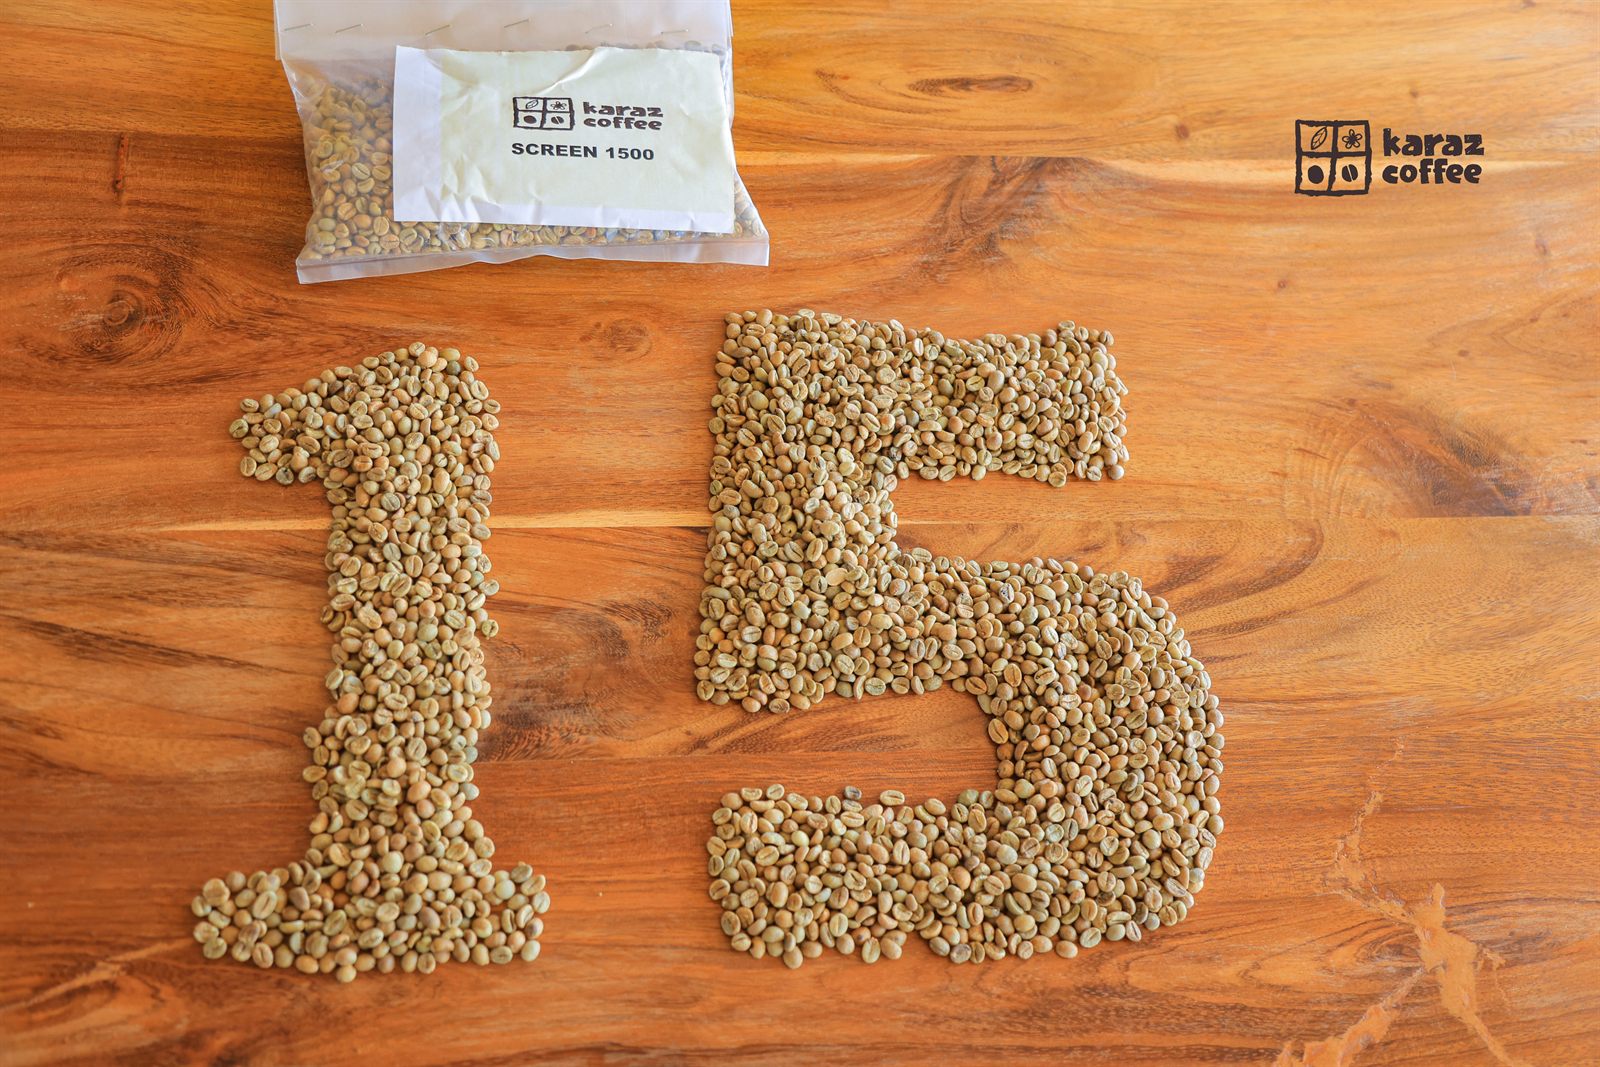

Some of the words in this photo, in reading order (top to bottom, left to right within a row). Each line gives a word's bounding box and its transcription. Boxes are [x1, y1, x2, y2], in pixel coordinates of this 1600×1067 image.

[583, 102, 664, 118] karaz
[583, 117, 663, 131] coffee
[511, 142, 598, 158] SCREEN
[605, 147, 654, 160] 1500
[191, 309, 1224, 982] 15
